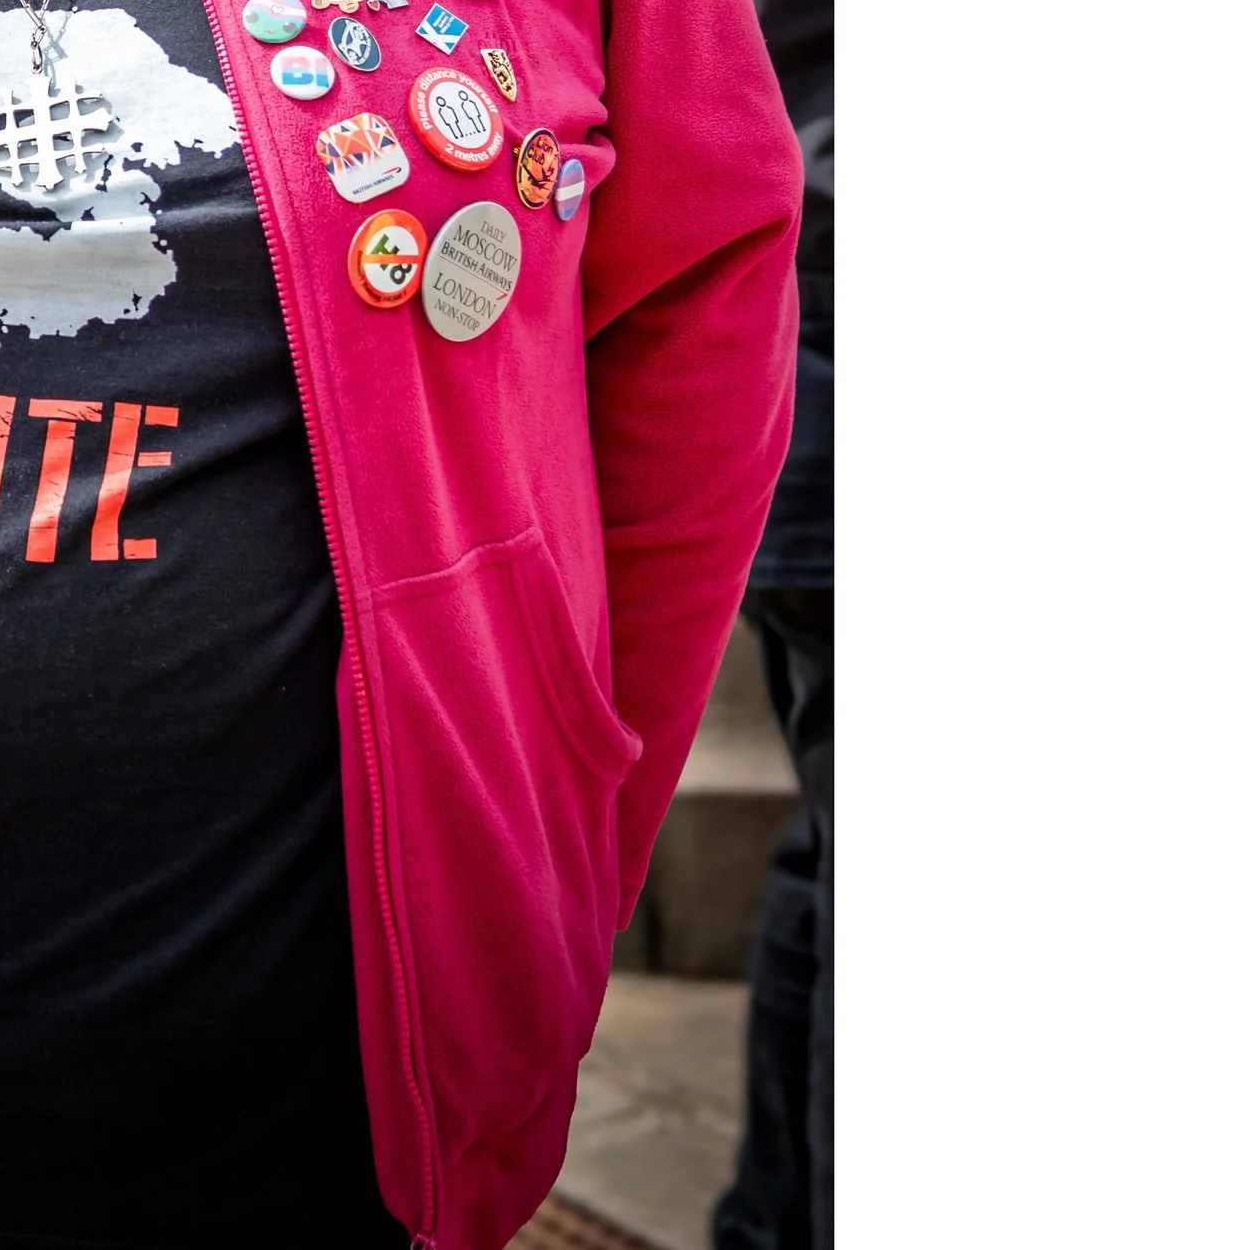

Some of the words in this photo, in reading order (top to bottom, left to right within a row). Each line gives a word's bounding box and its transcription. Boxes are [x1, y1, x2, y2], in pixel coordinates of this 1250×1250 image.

[281, 56, 330, 88] BI
[418, 70, 457, 91] distance
[417, 91, 433, 131] Please
[458, 74, 499, 114] yourself
[444, 143, 455, 154] 2
[454, 150, 489, 162] metres
[486, 131, 503, 156] away
[452, 224, 519, 273] MOSCOW
[480, 220, 508, 244] DAILY
[440, 241, 479, 272] BRITISH
[477, 262, 514, 293] AIRWAYS
[432, 272, 498, 320] LONDON
[433, 298, 481, 332] NON-STOP
